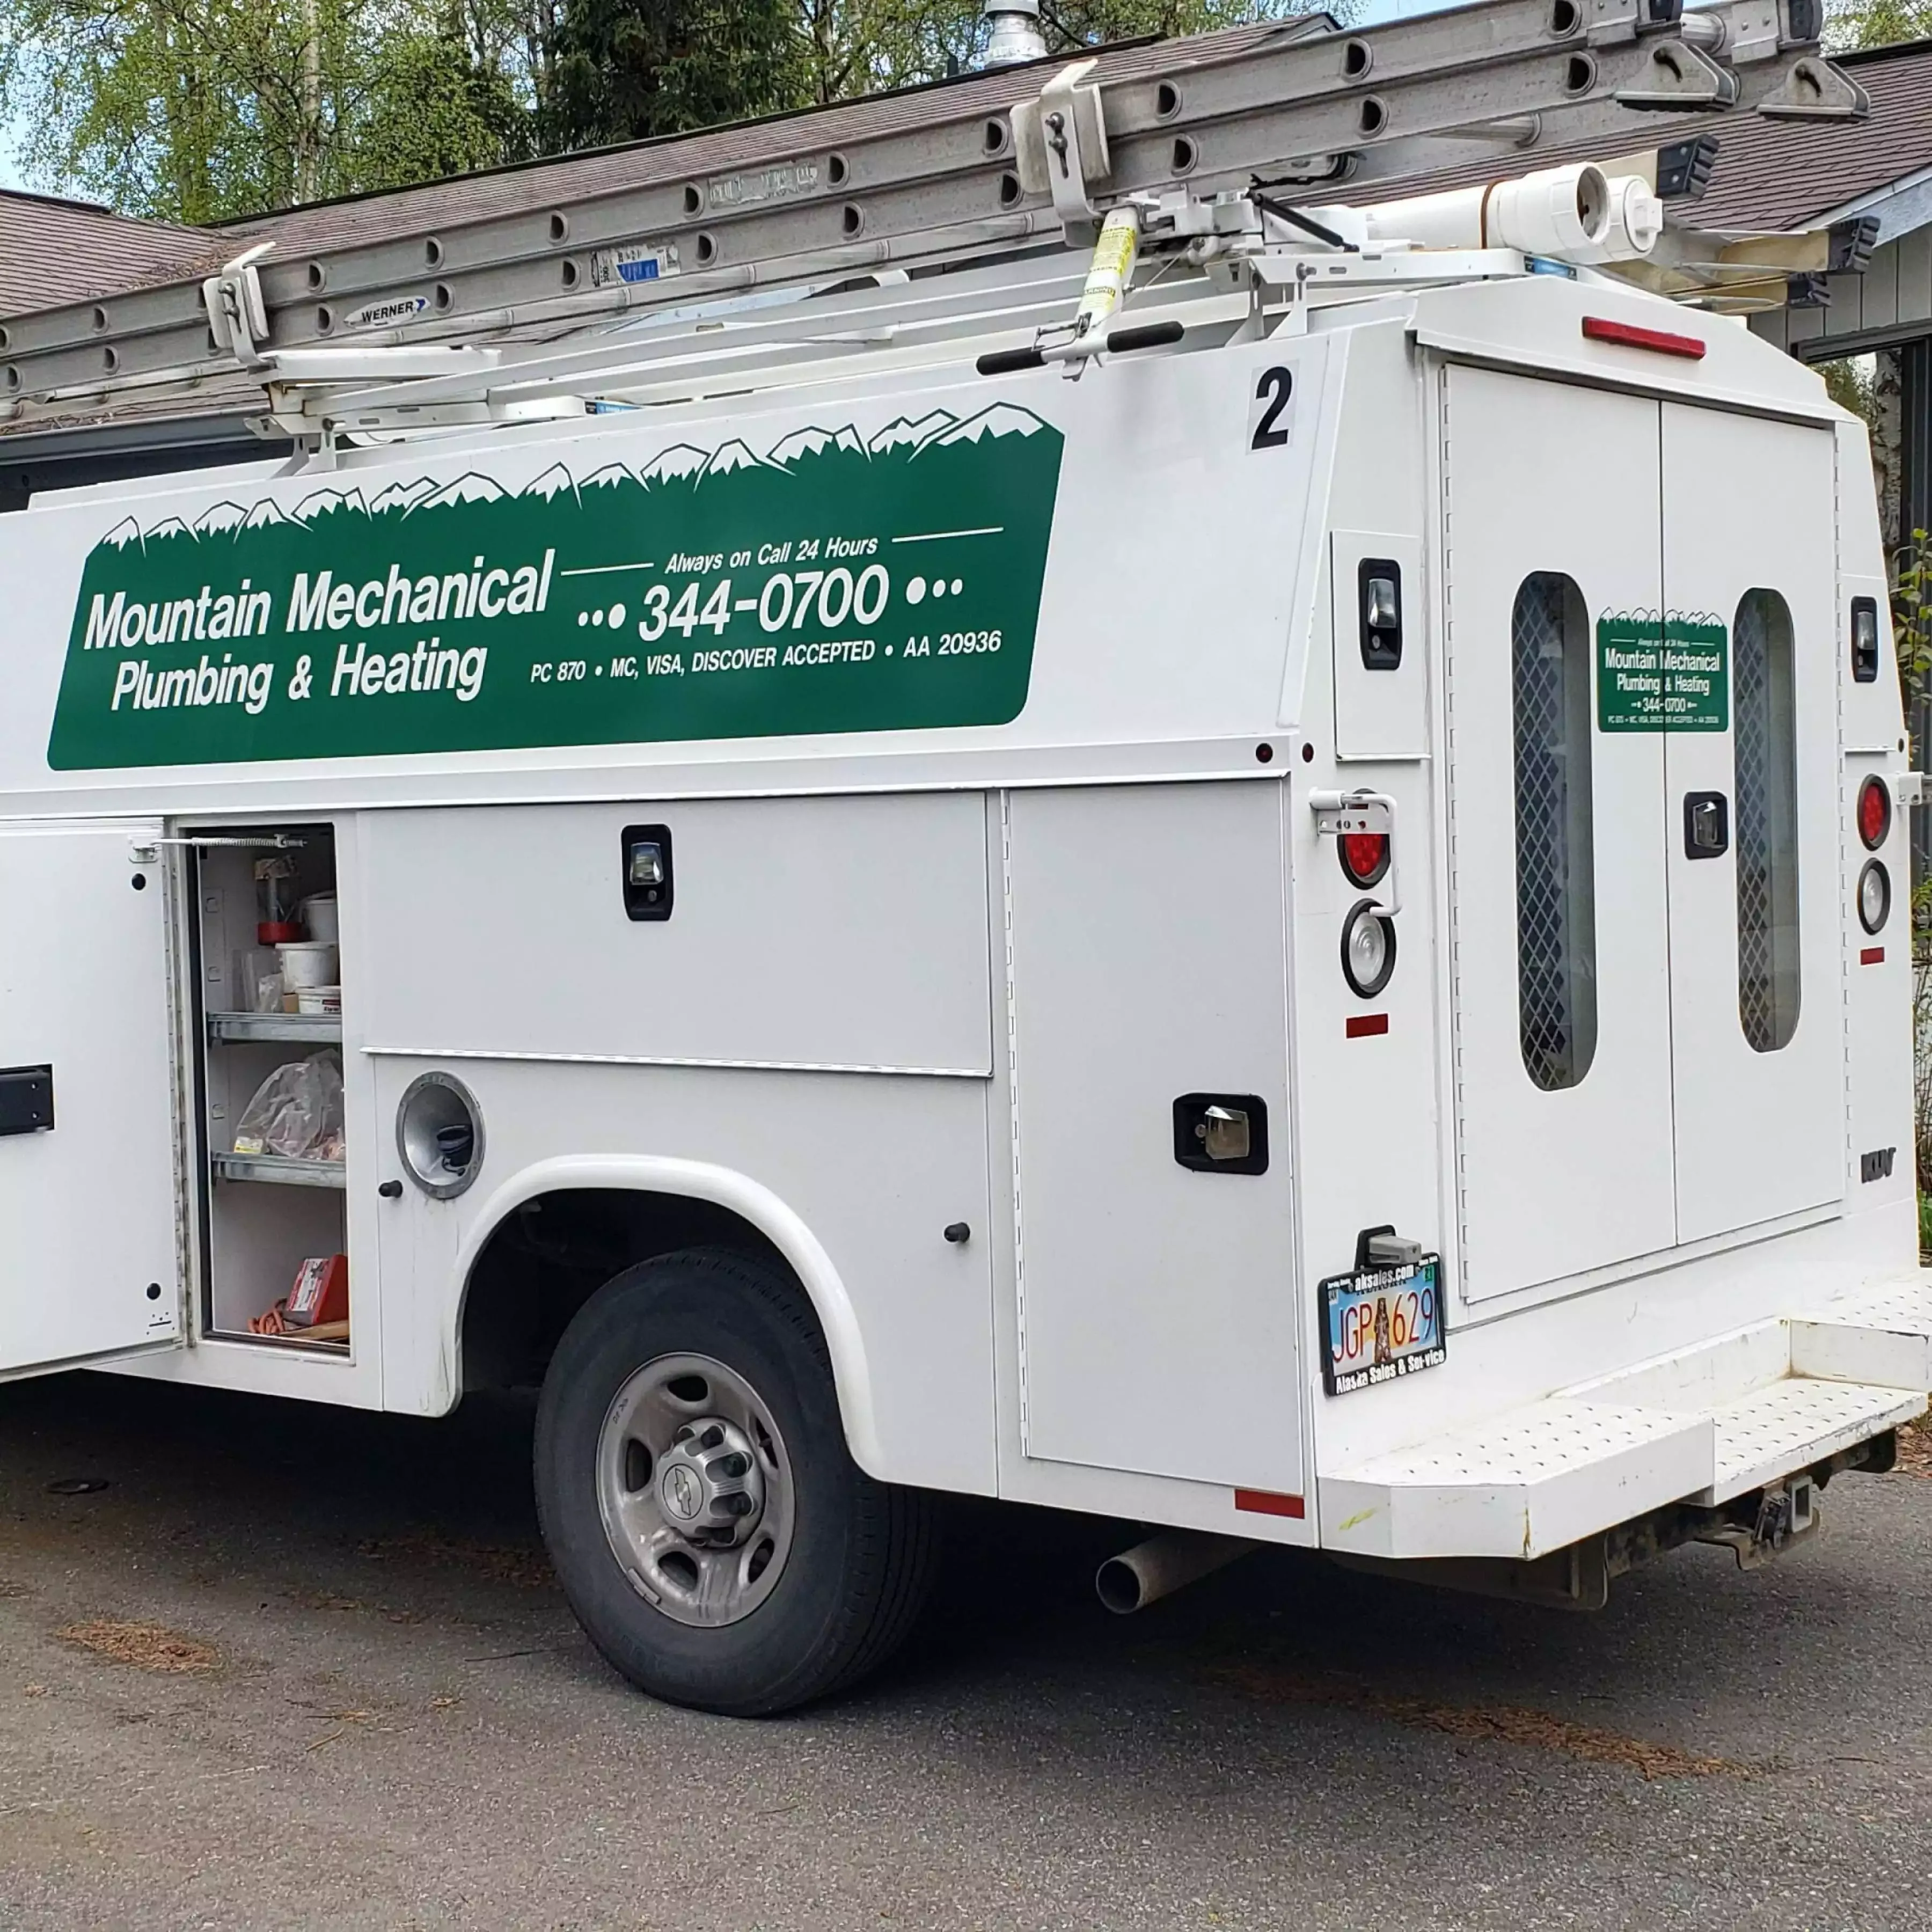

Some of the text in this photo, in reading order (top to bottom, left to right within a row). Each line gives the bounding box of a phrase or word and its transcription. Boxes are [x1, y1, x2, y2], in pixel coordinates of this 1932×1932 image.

[362, 301, 413, 322] WERNER
[1252, 366, 1292, 450] 2
[664, 537, 878, 574] Always on Call 24 Hours
[83, 548, 555, 650] Mountain Mechanical
[639, 564, 889, 641] 344-0700
[531, 630, 1002, 683] PC 870 MC, VISA, DISCOVER ACCEPTED AA 20936
[1605, 648, 1720, 671] Mountain Mechanical
[111, 637, 487, 714] Plumbing & Heating
[1616, 673, 1710, 696] Plumbing & Heating
[1642, 697, 1686, 713] 344-0700
[1355, 1264, 1414, 1291] aksales.com
[1331, 1288, 1433, 1363] JGP 629
[1336, 1371, 1368, 1394] Alaska
[1370, 1363, 1396, 1384] Sales
[1397, 1358, 1407, 1375] &
